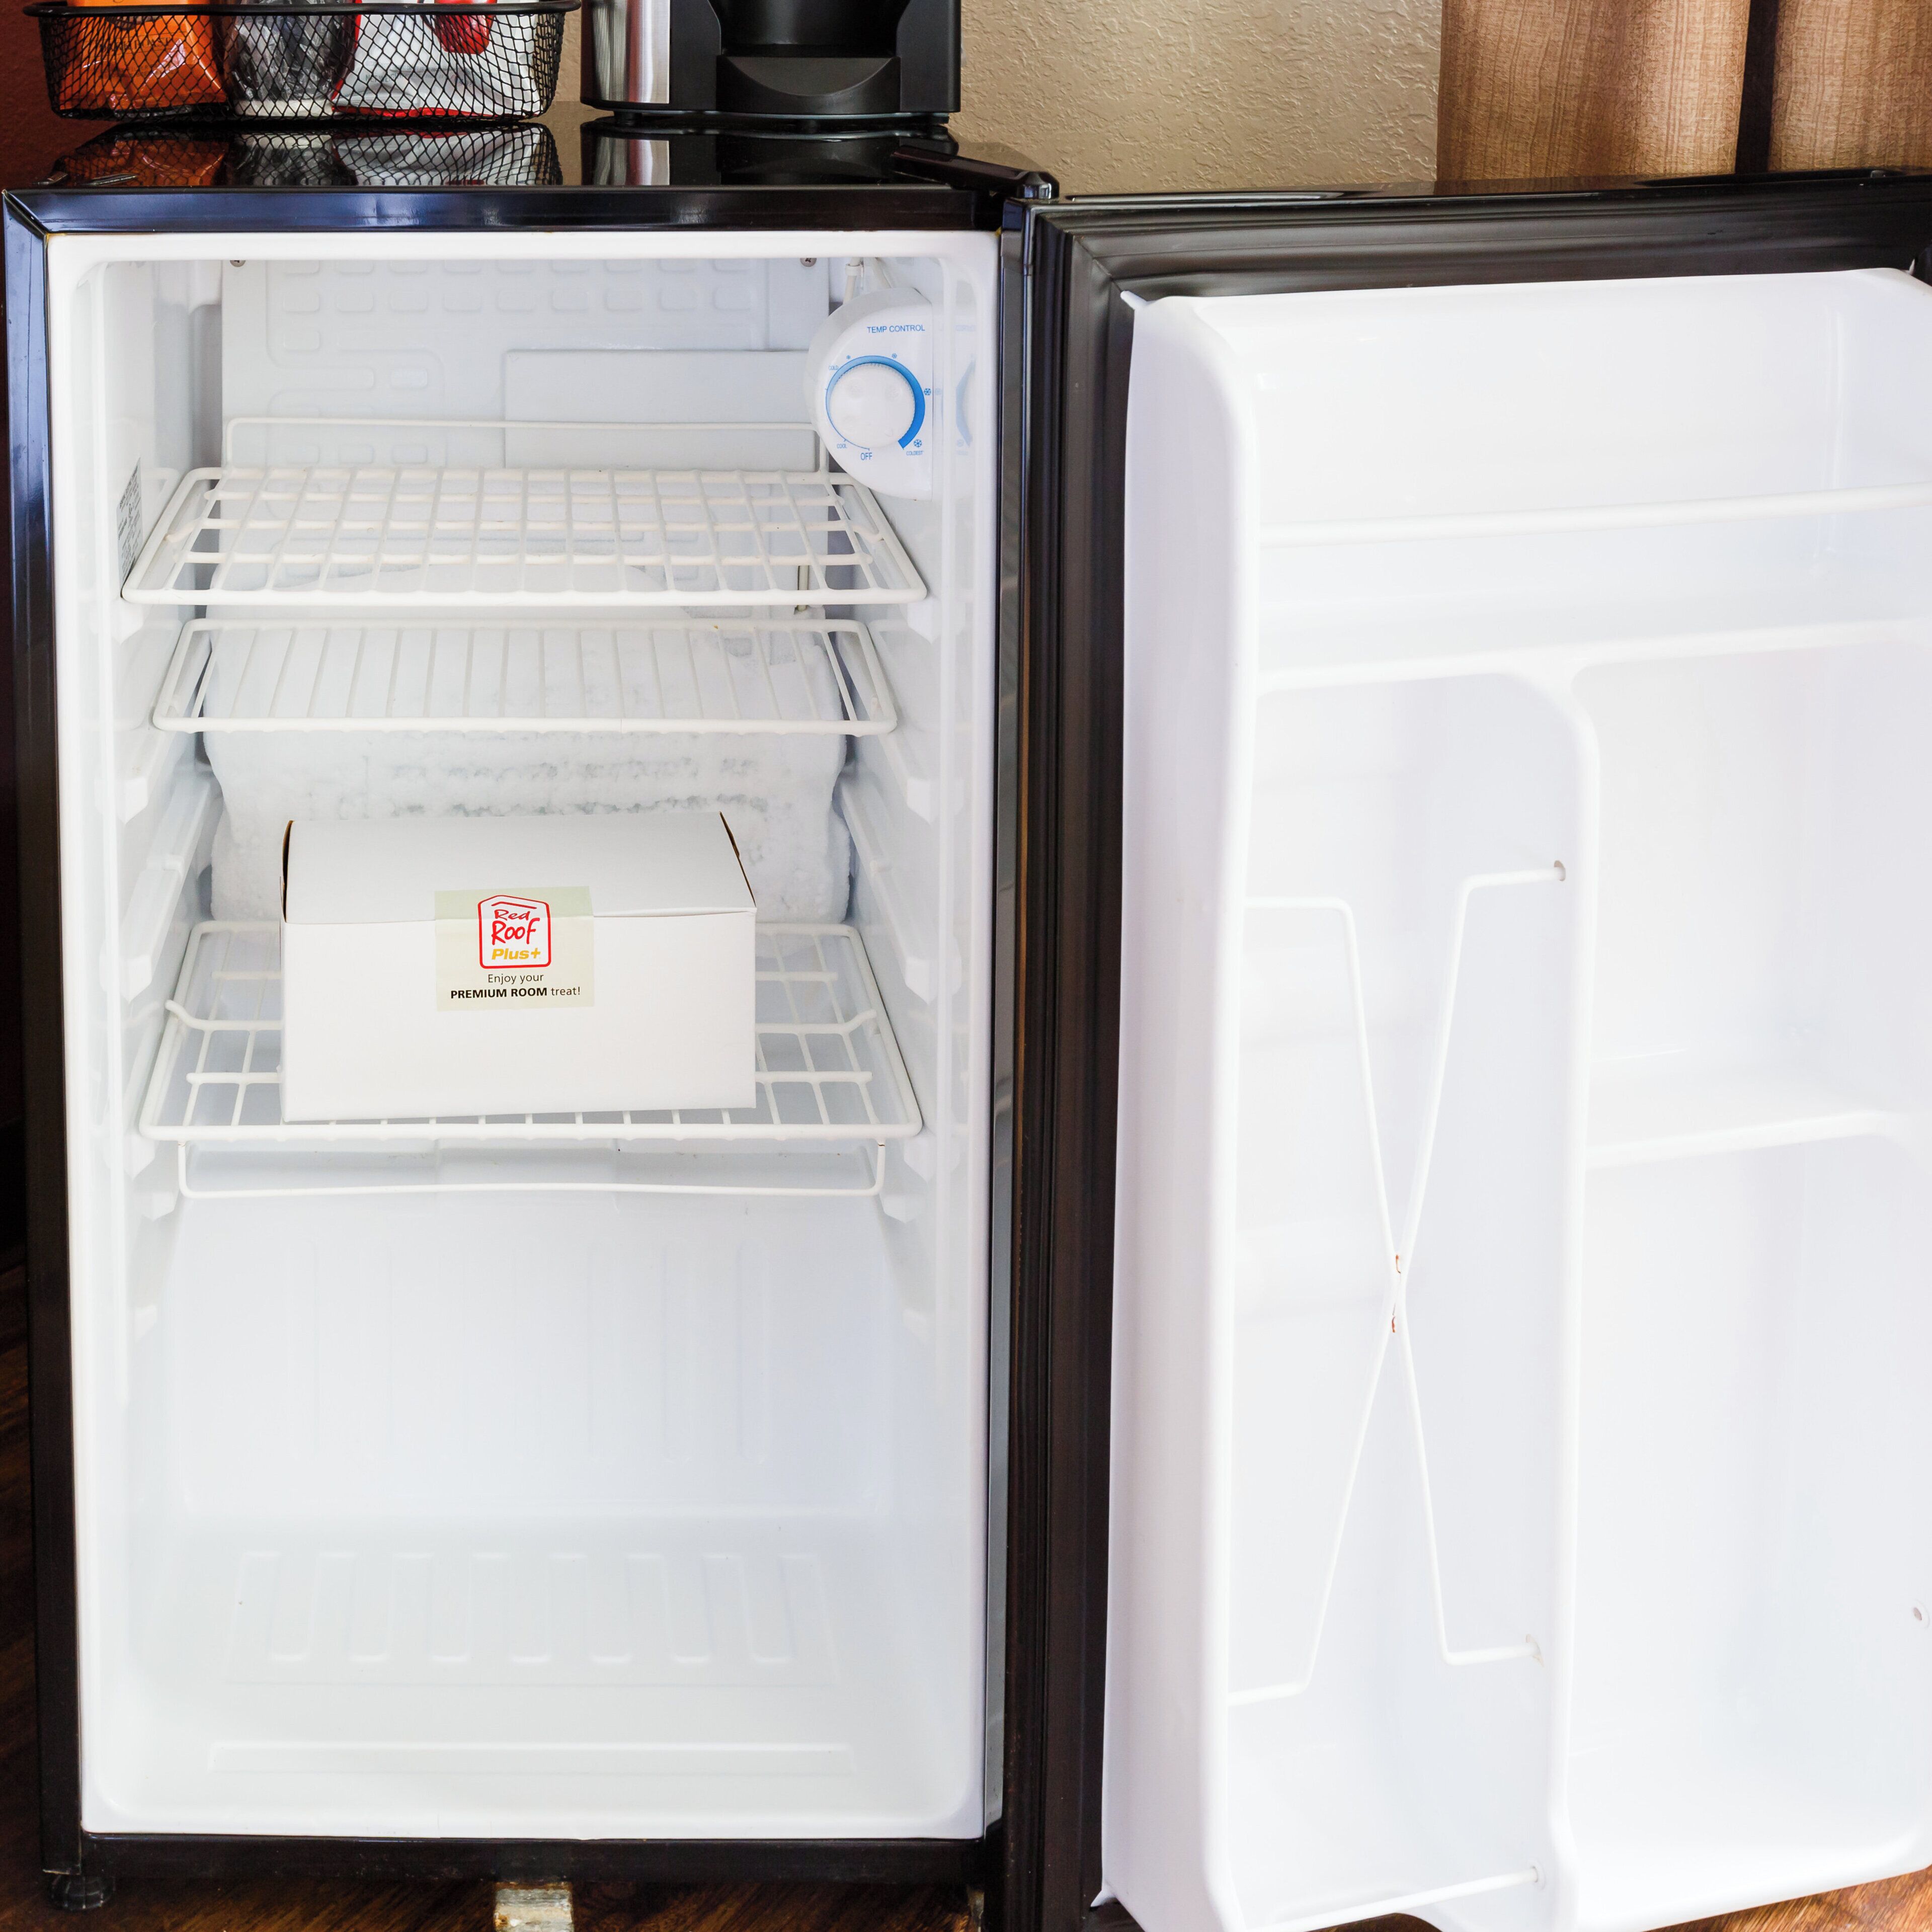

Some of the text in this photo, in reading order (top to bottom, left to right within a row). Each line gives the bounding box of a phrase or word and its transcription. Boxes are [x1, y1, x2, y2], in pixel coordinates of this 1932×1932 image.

[860, 452, 872, 460] OFF
[494, 909, 530, 921] Red
[491, 917, 540, 946] Roof
[492, 947, 541, 960] Plus+
[488, 974, 544, 985] Enjoy your
[451, 987, 580, 999] PREMIUM ROOM treat!
